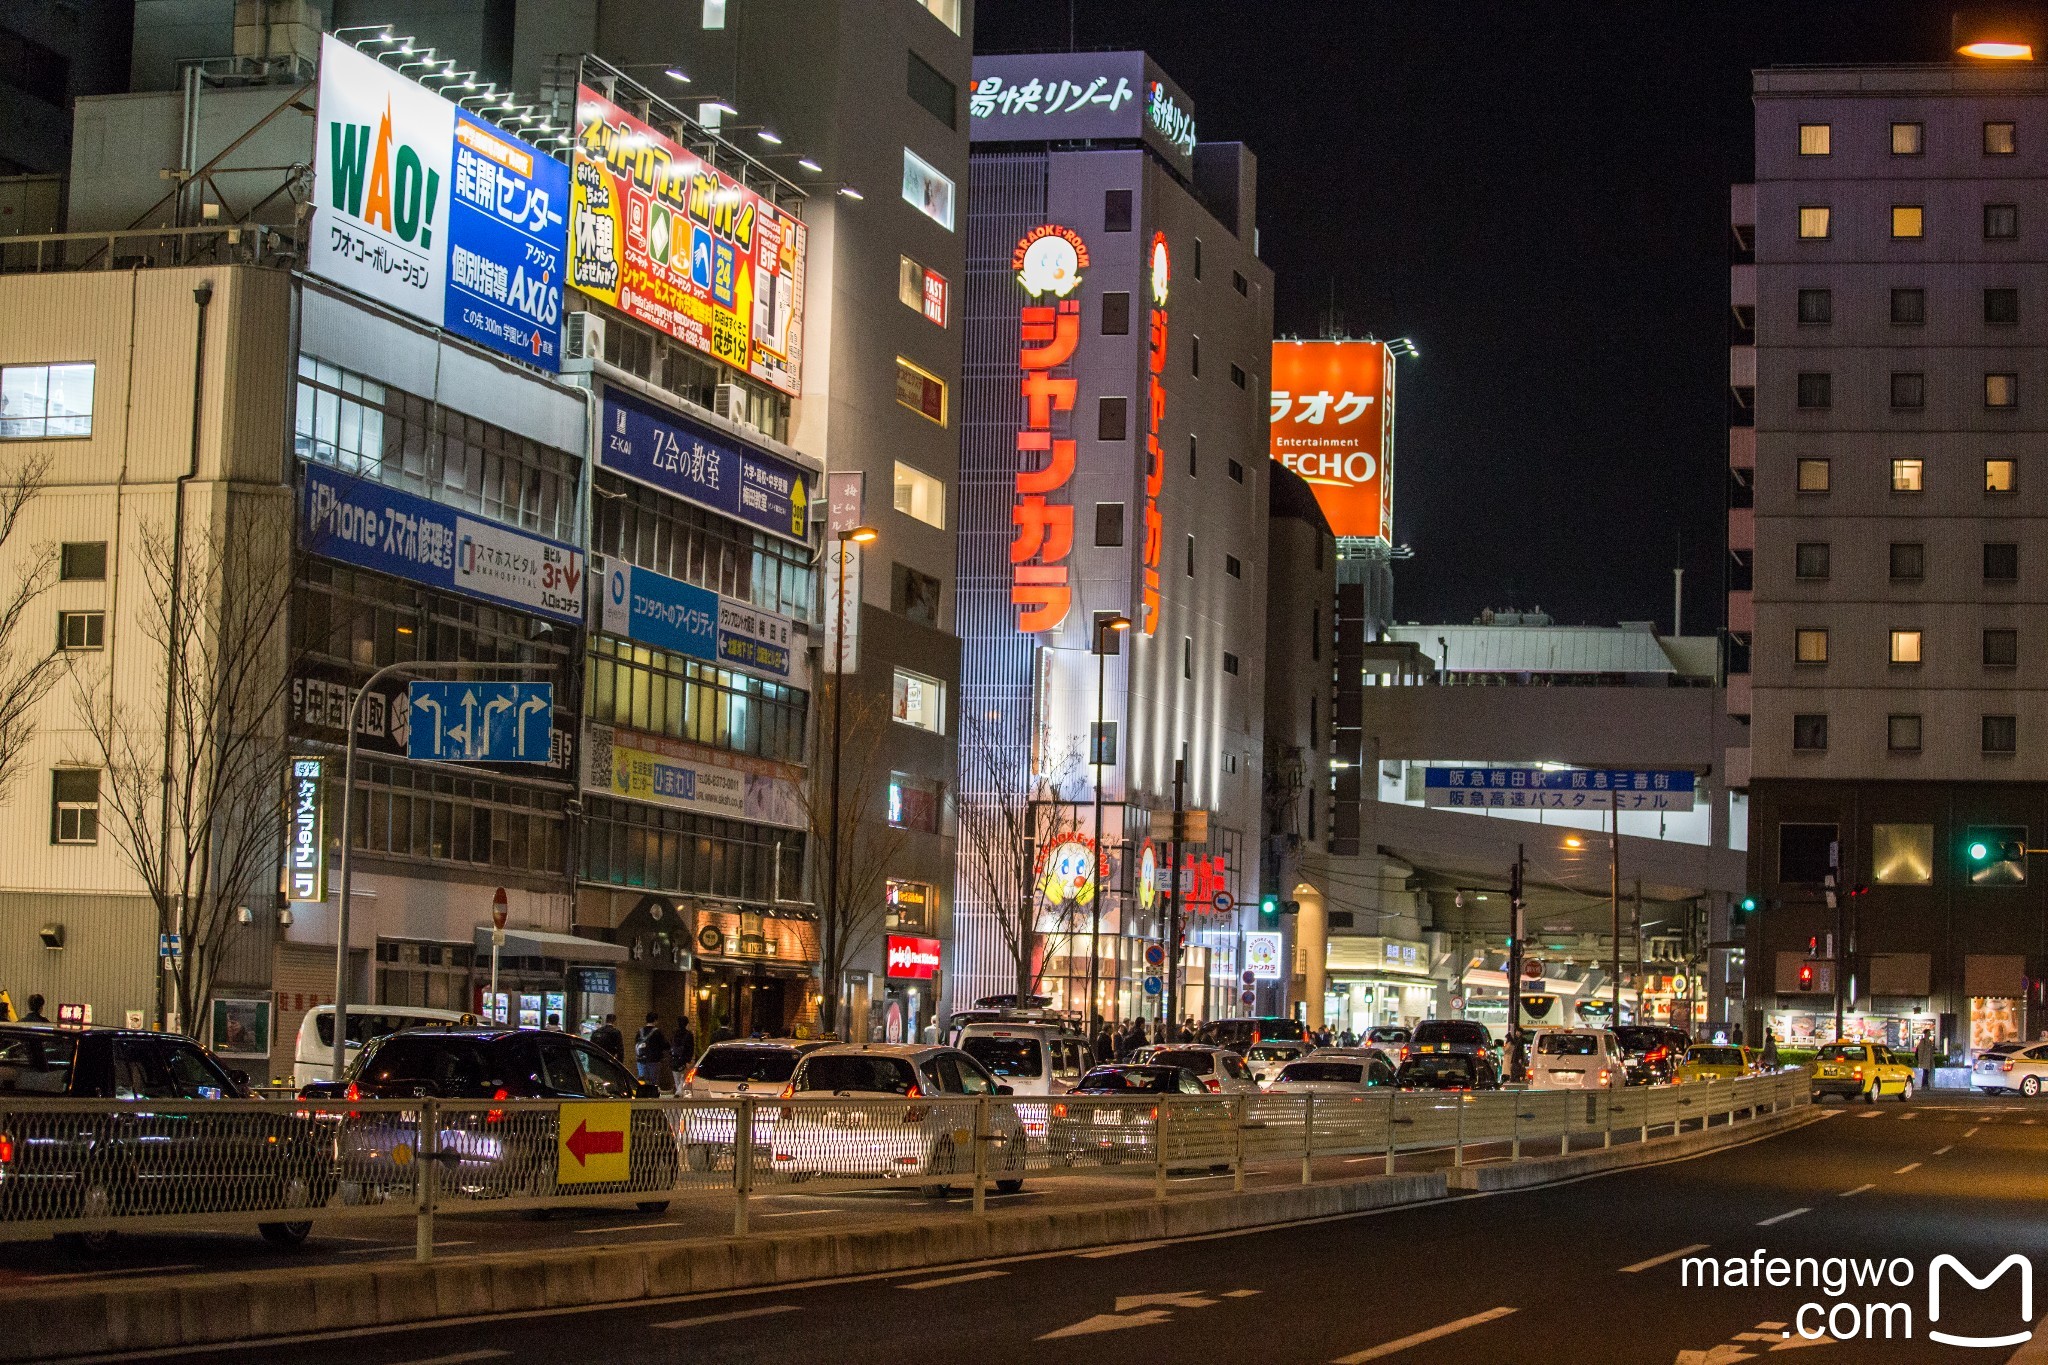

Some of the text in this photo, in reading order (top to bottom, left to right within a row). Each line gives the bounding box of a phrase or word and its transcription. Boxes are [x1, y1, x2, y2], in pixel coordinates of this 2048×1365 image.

[330, 90, 441, 251] WAO!
[456, 147, 563, 232] 能開センター
[575, 203, 614, 262] 休憩
[331, 226, 430, 290] ワオ・コーポレーション
[525, 242, 557, 274] アクシス
[715, 258, 732, 289] 24
[452, 243, 559, 326] 個別指導 Axis
[925, 276, 943, 299] FAST
[463, 308, 530, 348] この先 300m 学園ビル
[924, 299, 942, 323] MAIL
[713, 325, 747, 366] 徒歩1分
[652, 429, 721, 491] Z会の教室
[1276, 437, 1359, 447] Entertainment
[1011, 299, 1080, 633] ジャンカラ
[475, 543, 538, 576] スマホスピタル
[541, 562, 562, 591] 3F
[540, 591, 581, 614] 入口はコチラ
[633, 595, 715, 639] コンタクトのアイシティ
[654, 765, 695, 797] ひまわり
[1449, 790, 1669, 809] 阪急高速バスターミナル
